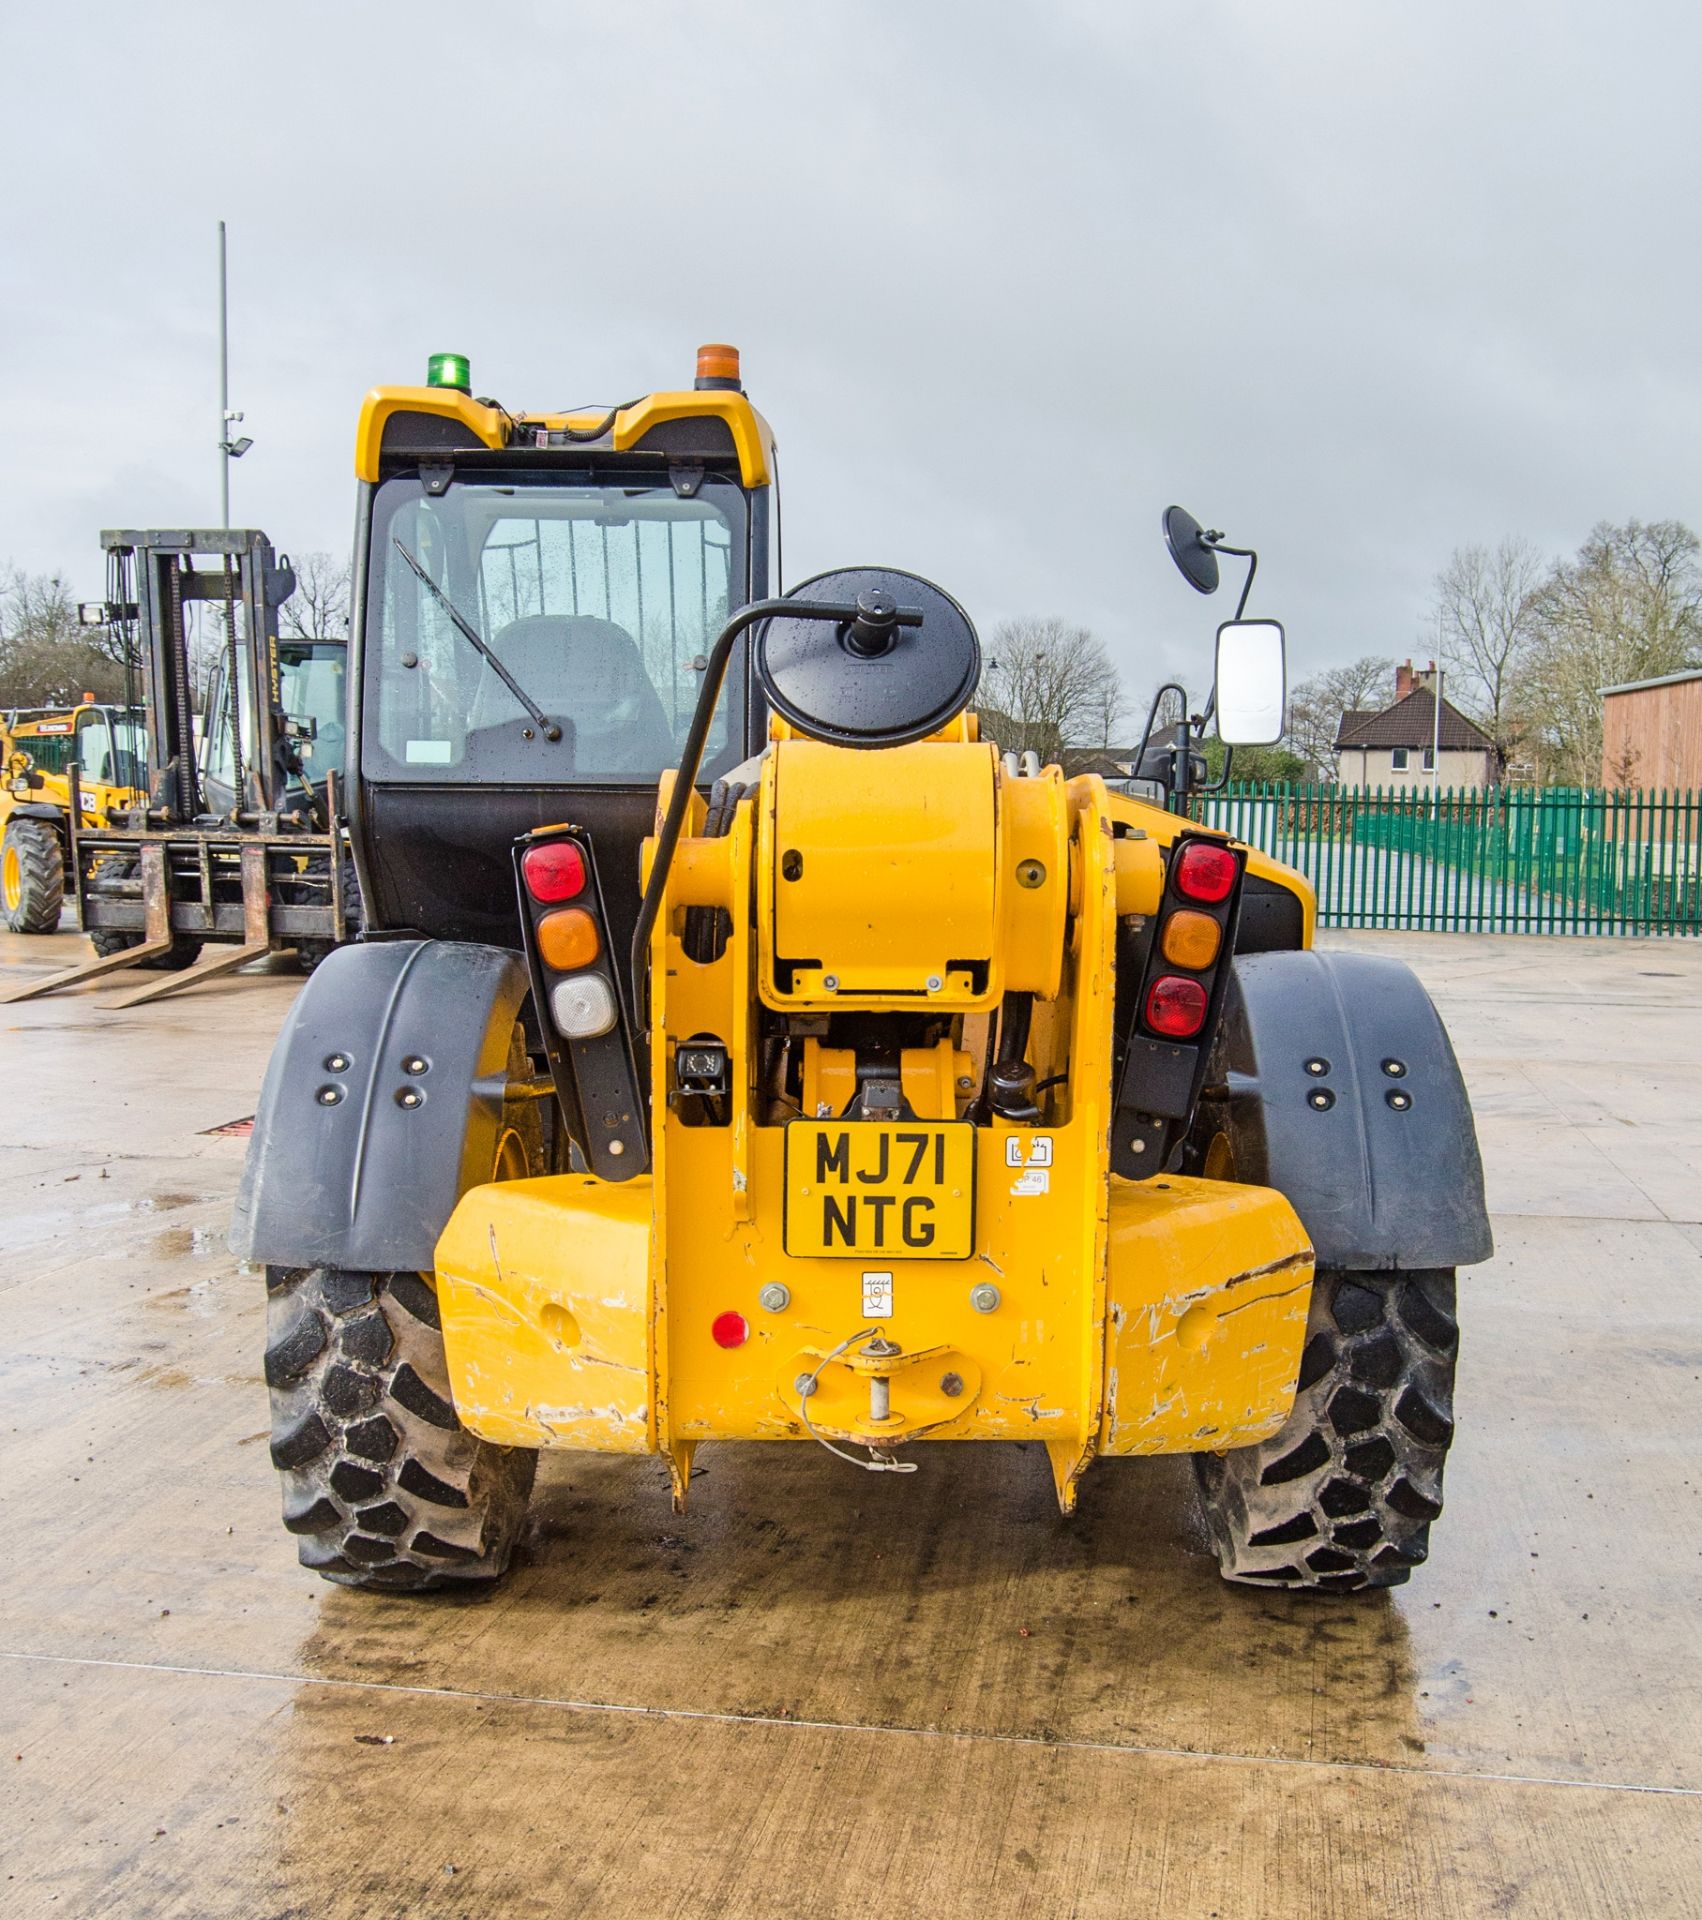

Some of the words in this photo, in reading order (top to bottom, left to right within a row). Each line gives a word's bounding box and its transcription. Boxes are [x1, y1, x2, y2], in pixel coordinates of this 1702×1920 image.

[269, 635, 279, 703] HYSTER
[79, 791, 97, 813] CB
[816, 1132, 944, 1185] MJ71
[1031, 1175, 1042, 1184] 46
[823, 1195, 936, 1248] NTG
